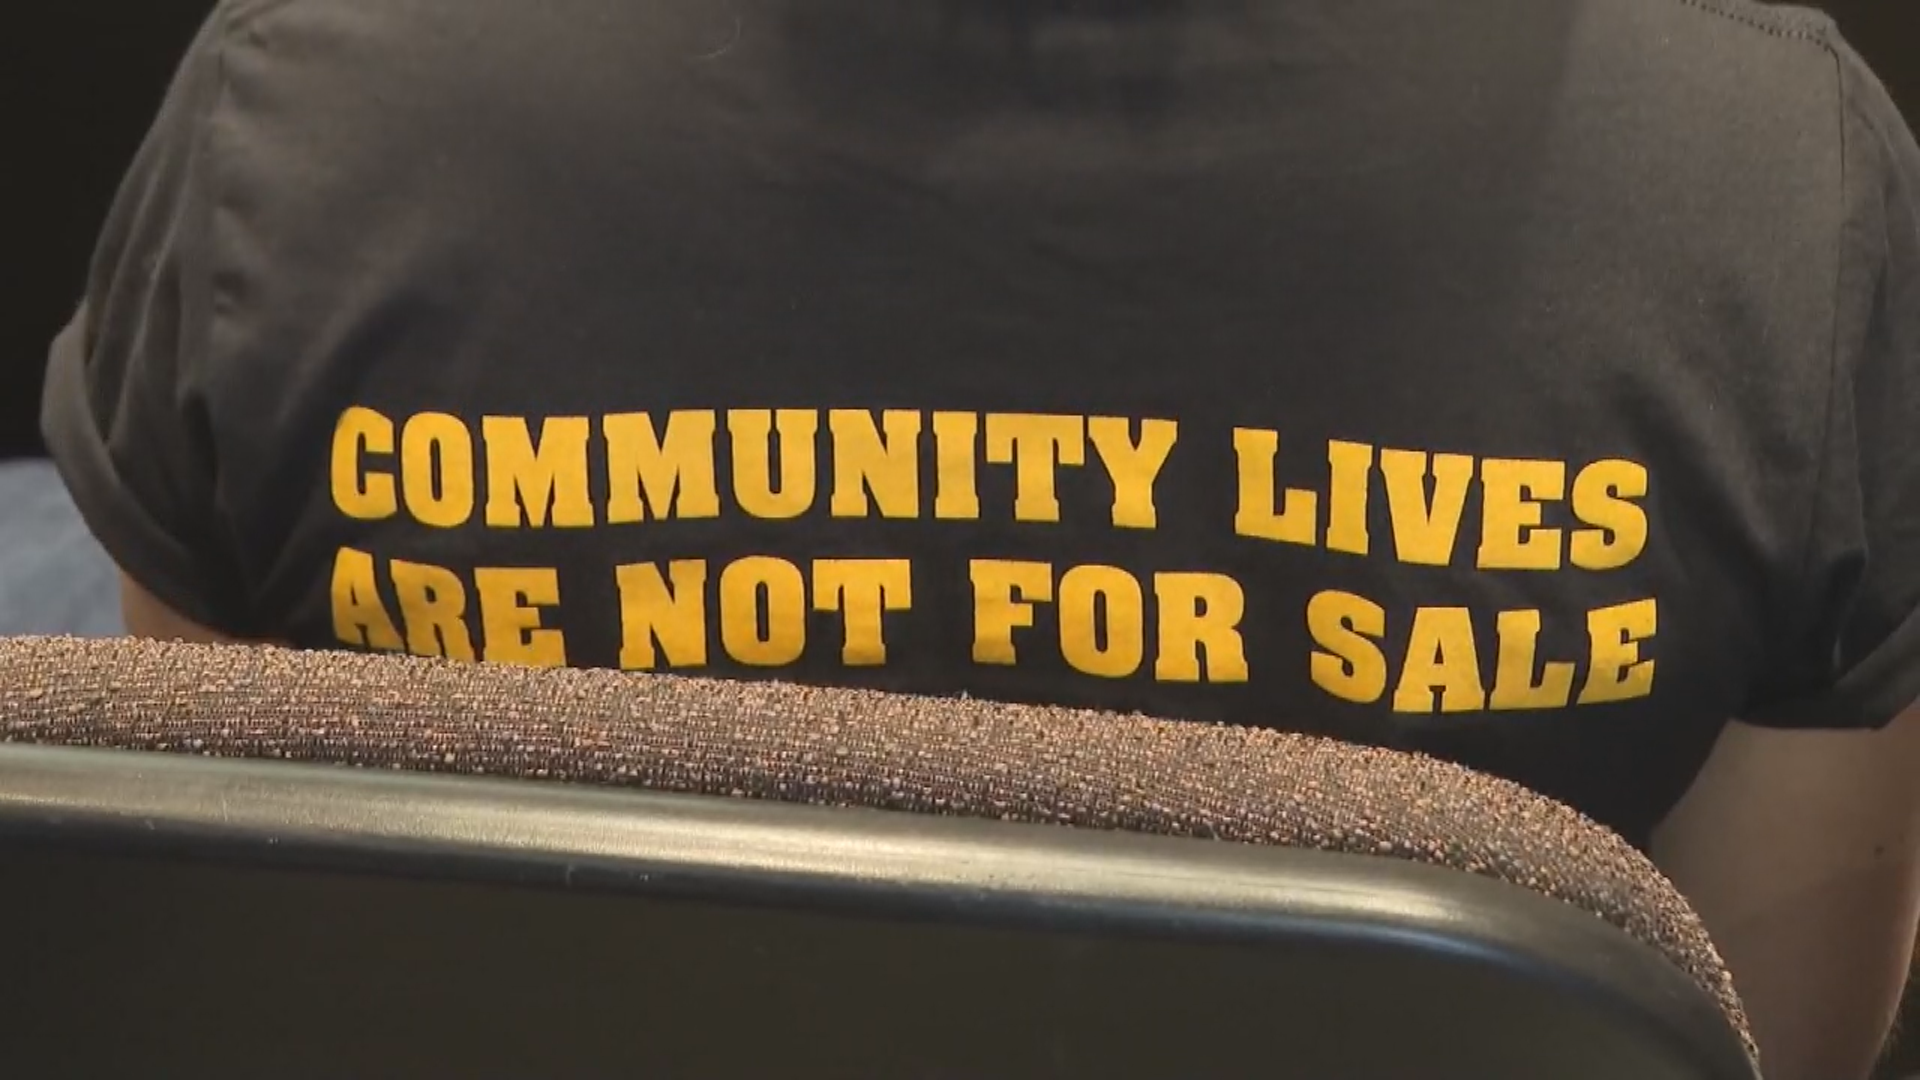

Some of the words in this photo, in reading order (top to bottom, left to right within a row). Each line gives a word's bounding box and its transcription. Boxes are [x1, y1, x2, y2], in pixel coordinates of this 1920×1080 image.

[331, 406, 1177, 528] COMMUNITY
[1233, 427, 1648, 570] LIVES
[331, 547, 566, 668] ARE
[615, 556, 911, 670] NOT
[970, 559, 1249, 682] FOR
[1307, 589, 1657, 712] SALE
